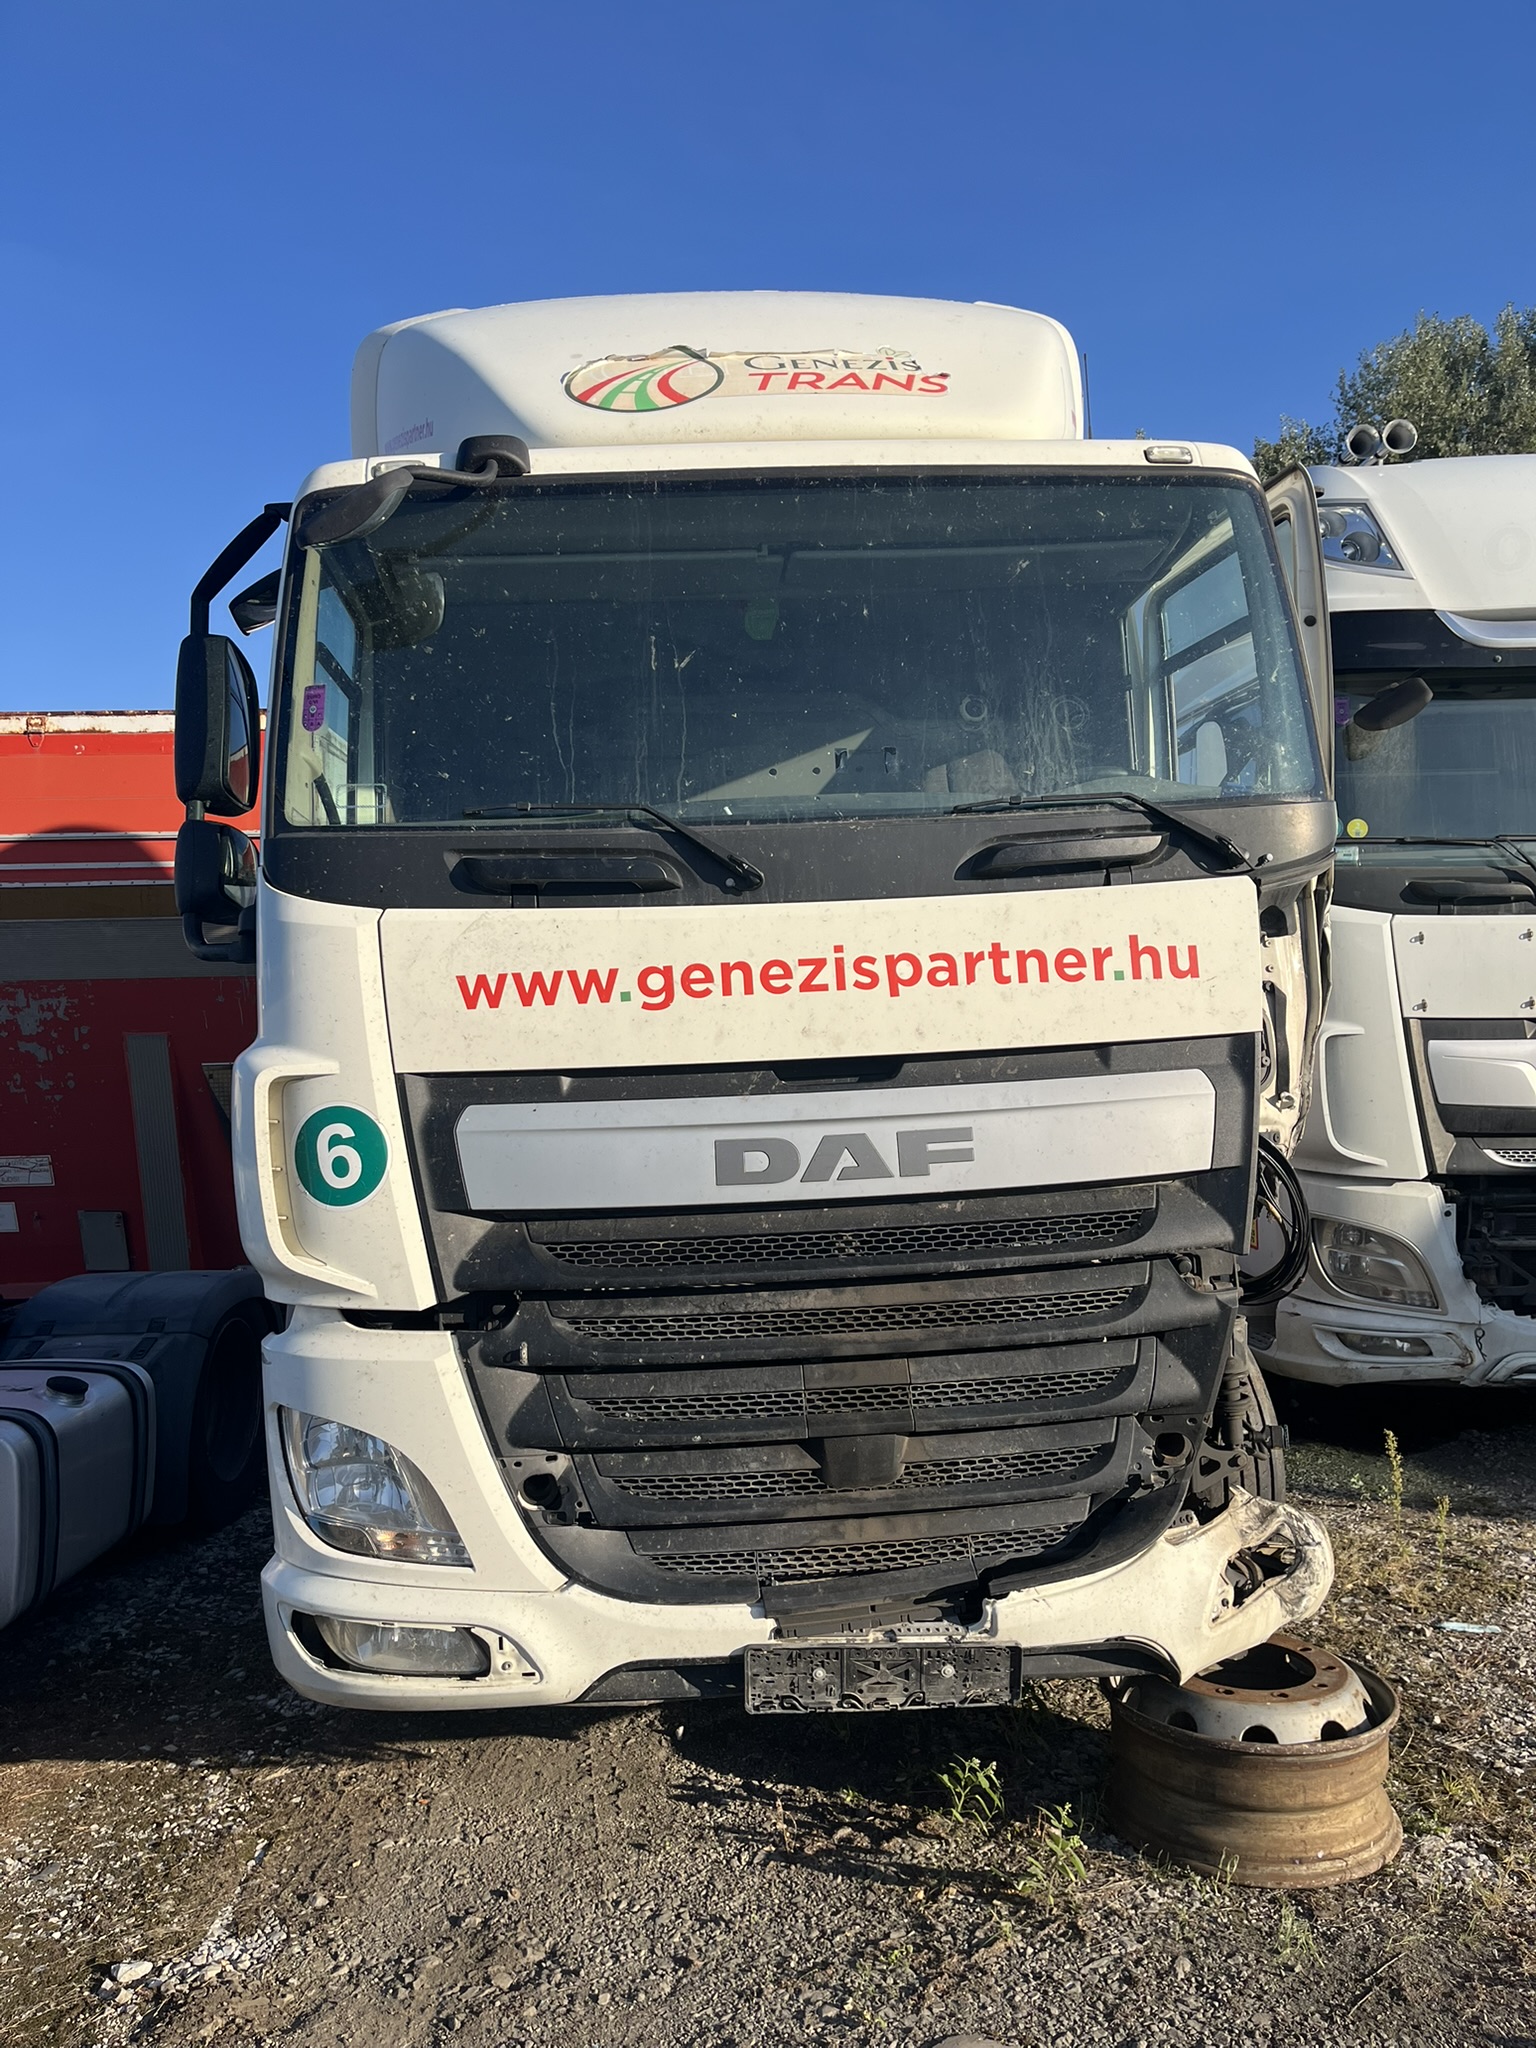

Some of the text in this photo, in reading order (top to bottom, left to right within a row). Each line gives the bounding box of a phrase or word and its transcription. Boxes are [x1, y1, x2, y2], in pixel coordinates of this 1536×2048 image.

[749, 372, 950, 393] TRANS
[456, 935, 1199, 1011] www.genezispartner.hu
[317, 1122, 362, 1189] 6
[715, 1127, 975, 1186] DAF
